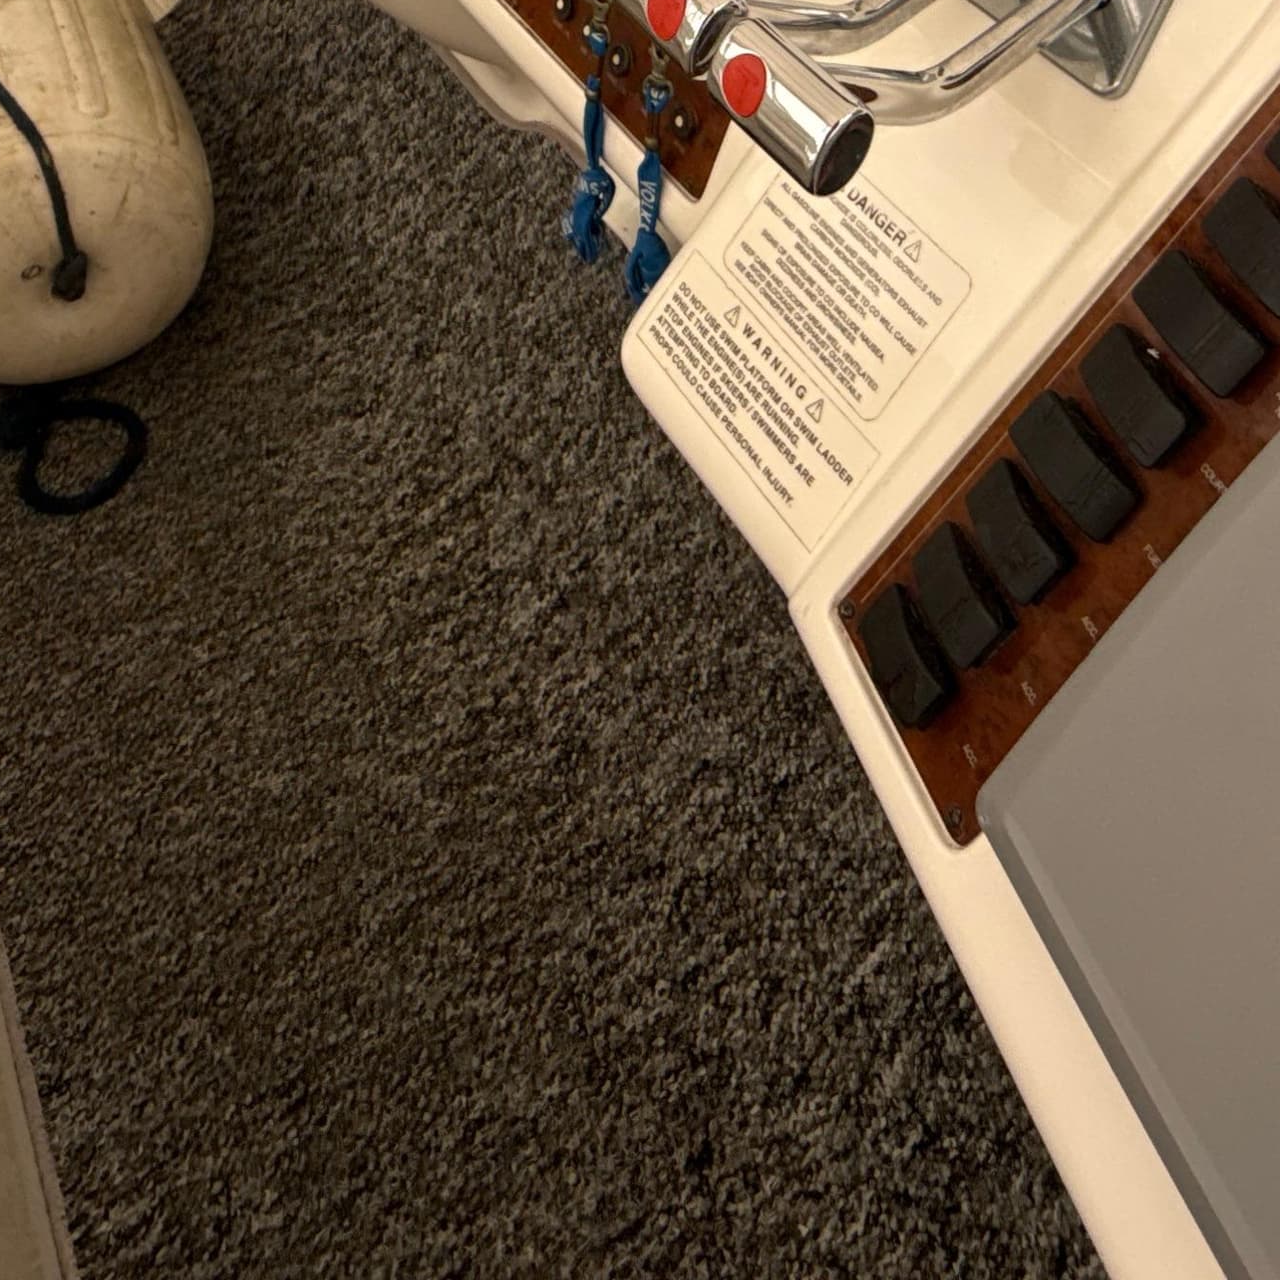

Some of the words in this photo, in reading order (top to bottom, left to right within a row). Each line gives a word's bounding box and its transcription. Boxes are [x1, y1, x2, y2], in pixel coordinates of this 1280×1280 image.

[845, 185, 908, 247] DANGER
[649, 324, 673, 356] PROPS
[671, 353, 697, 387] COULD
[695, 383, 722, 418] CAUSE
[720, 414, 763, 469] PERSONAL
[656, 313, 700, 369] ATTEMPTING
[663, 303, 683, 329] STOP
[681, 326, 714, 366] ENGINES
[719, 372, 749, 408] SKIERS
[751, 410, 796, 465] SWIMMERS
[794, 462, 814, 487] ARE
[671, 292, 694, 321] WHILE
[693, 318, 709, 338] THE
[706, 335, 746, 384] ENGINE(S)
[743, 379, 762, 403] ARE
[760, 399, 800, 448] RUNNING.
[689, 294, 706, 315] NOT
[704, 311, 720, 333] USE
[719, 329, 741, 356] SWIM
[739, 353, 782, 404] PLATFORM
[793, 416, 817, 446] SWIM
[816, 442, 853, 487] LADDER
[741, 323, 808, 401] WARNING
[1143, 544, 1161, 568] FUE
